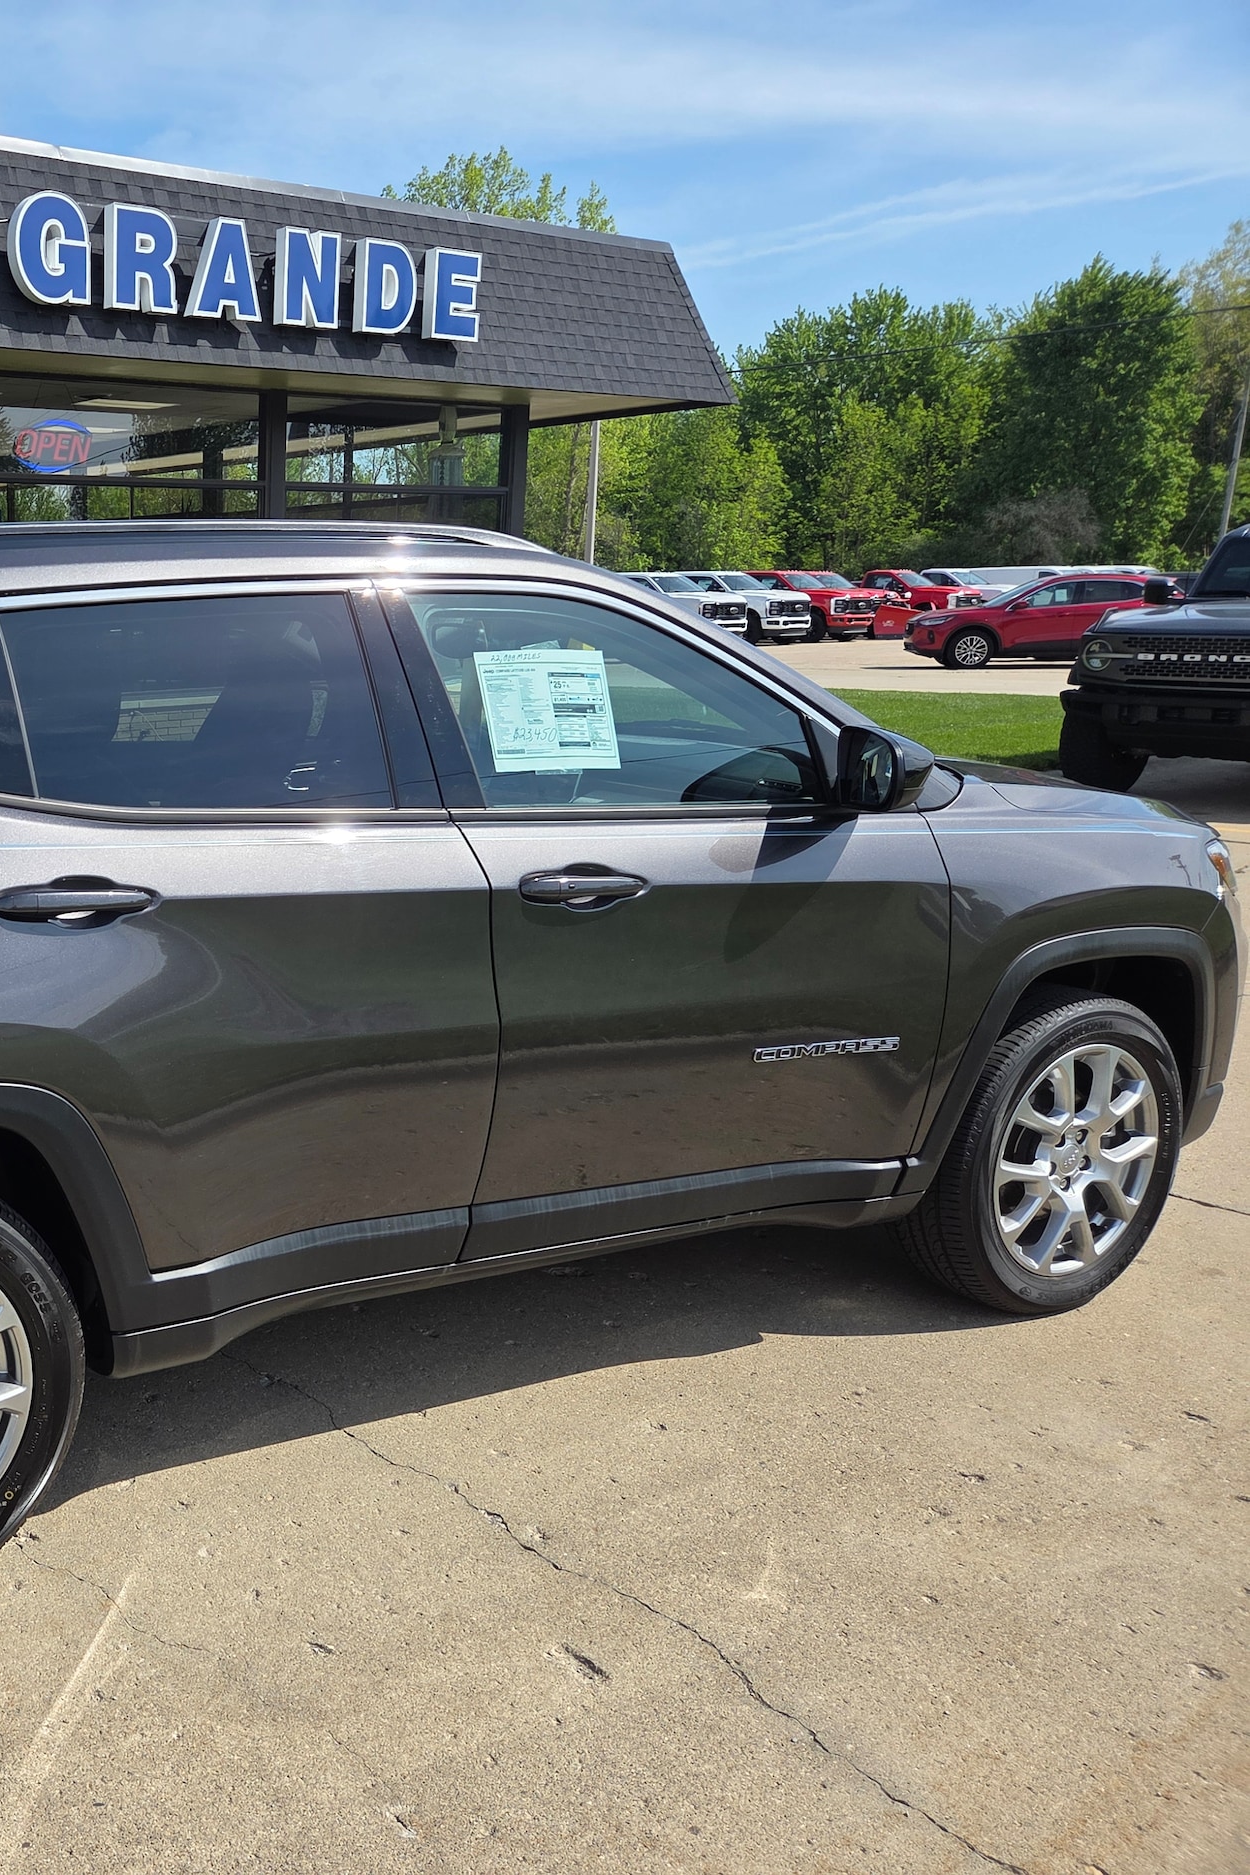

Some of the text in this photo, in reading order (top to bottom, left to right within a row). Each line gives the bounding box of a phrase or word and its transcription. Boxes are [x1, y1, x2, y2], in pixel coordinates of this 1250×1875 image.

[7, 190, 483, 343] GRANDE
[16, 429, 92, 463] OPEN
[513, 727, 558, 743] $23,450
[753, 1036, 901, 1063] COMPASS
